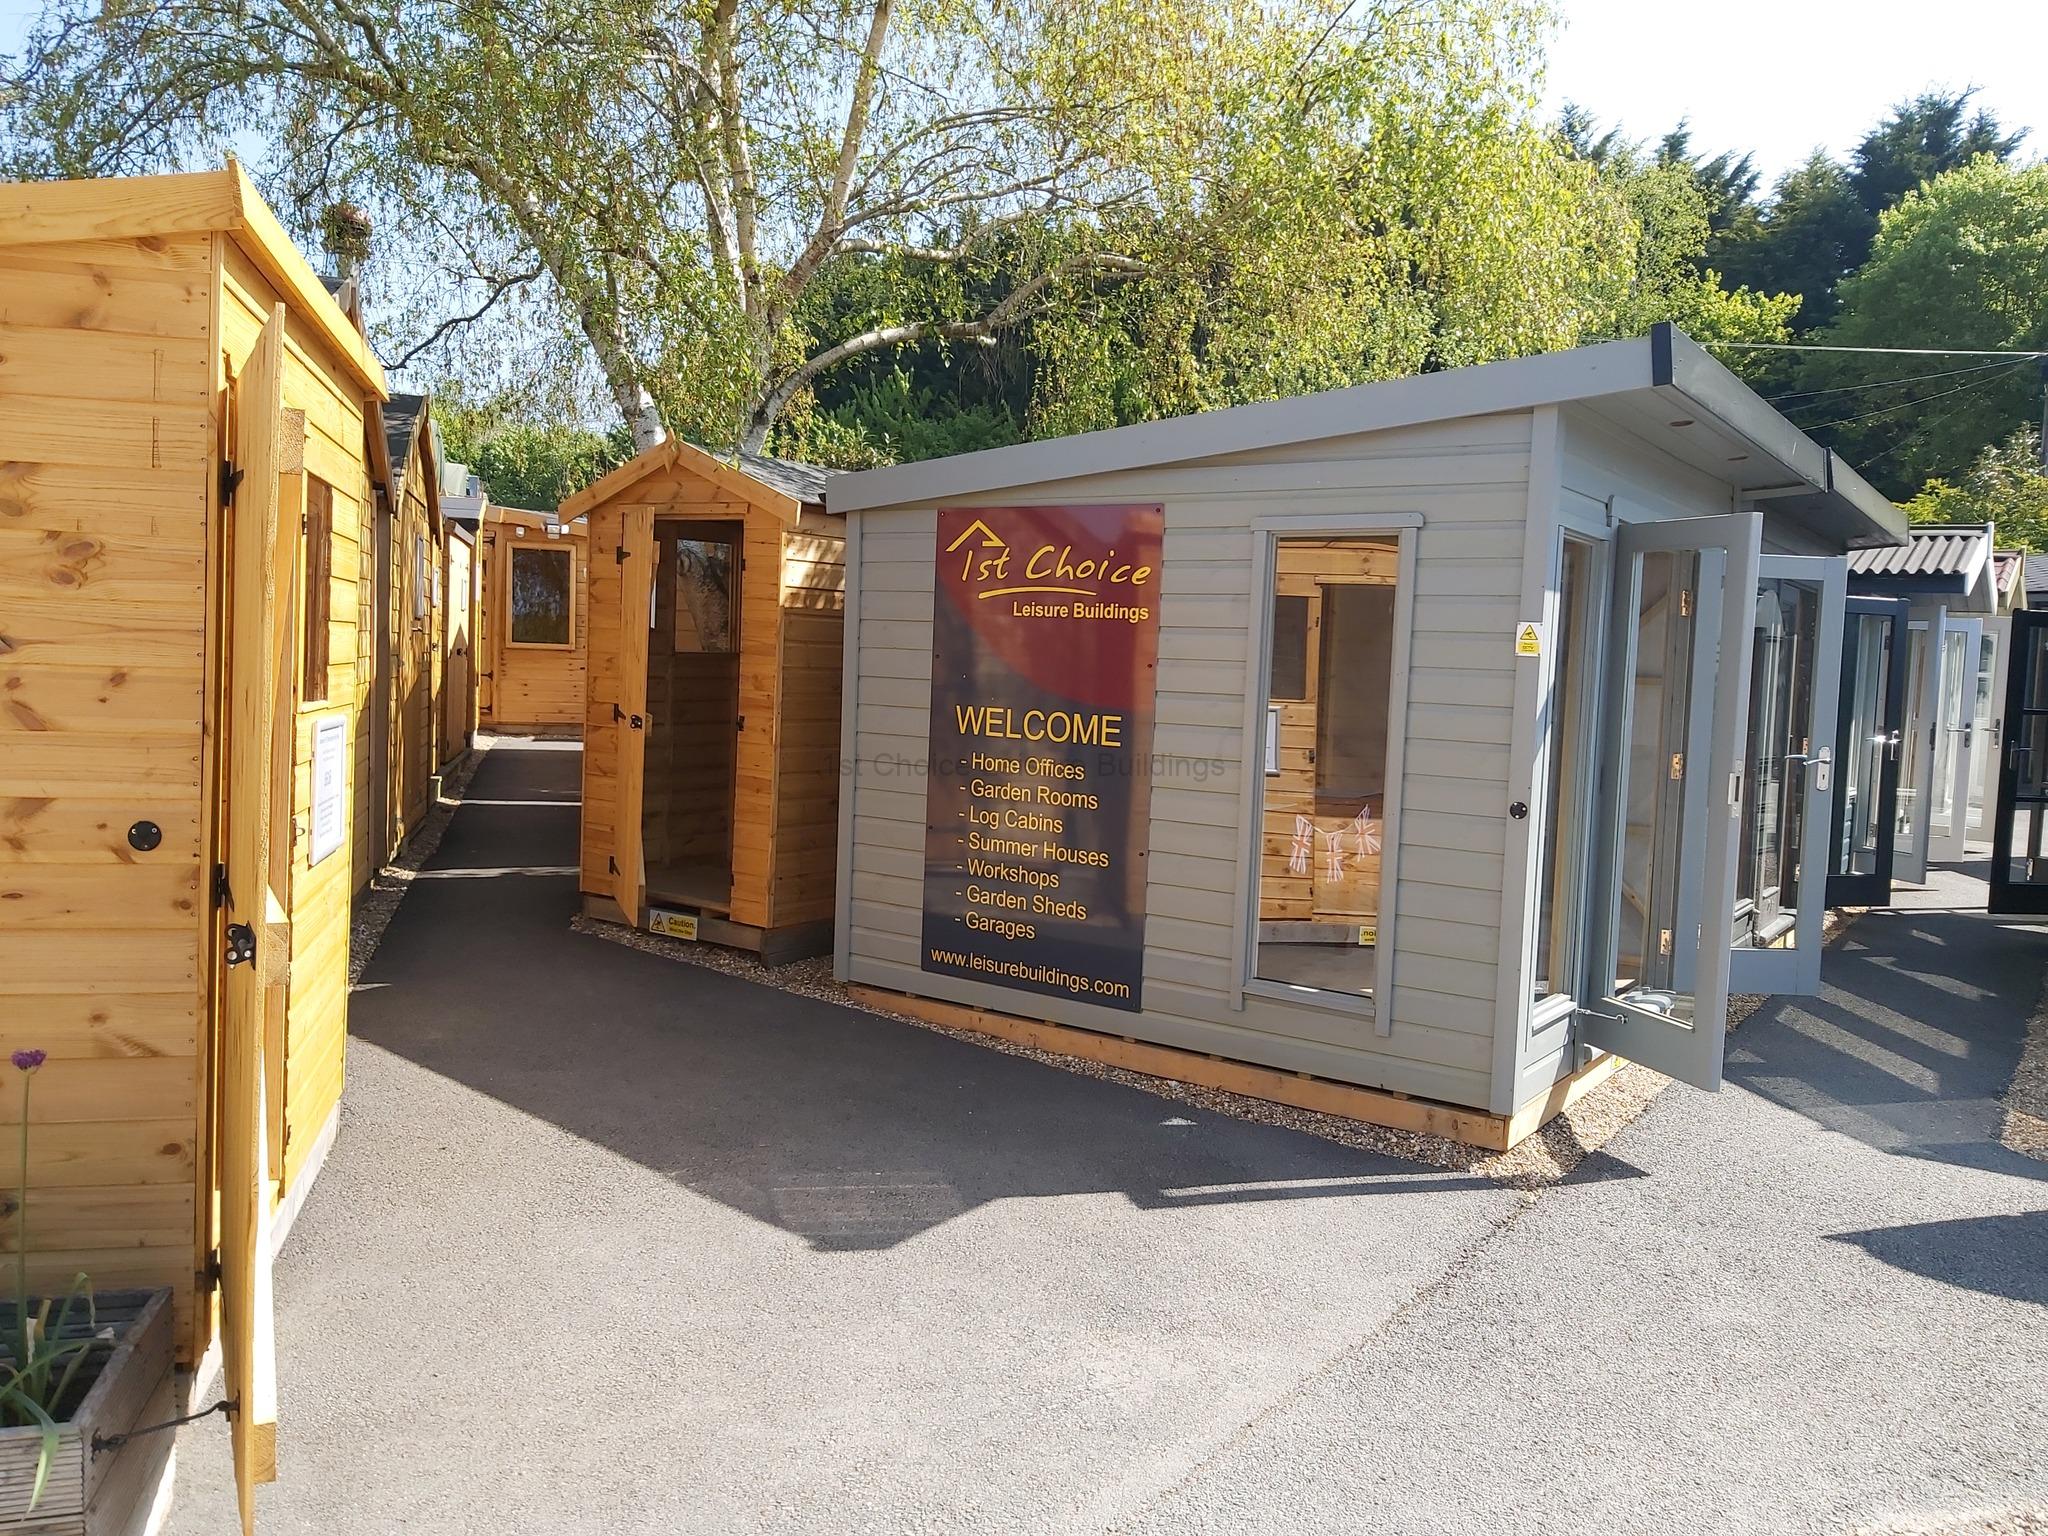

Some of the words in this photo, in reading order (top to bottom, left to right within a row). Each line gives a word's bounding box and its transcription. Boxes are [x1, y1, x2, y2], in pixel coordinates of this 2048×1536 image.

[961, 547, 1010, 582] 1st
[1025, 545, 1152, 585] Choice
[1013, 601, 1069, 618] Leisure
[1073, 602, 1149, 624] Buildings
[956, 705, 1122, 747] WELCOME
[972, 752, 1020, 774] Home
[1025, 757, 1085, 780] Offices
[971, 778, 1031, 803] Garden
[1037, 785, 1098, 810] Rooms
[969, 805, 1000, 830] Log
[1004, 809, 1063, 834] Cabins
[968, 831, 1038, 858] Summer
[1043, 840, 1109, 867] Houses
[967, 857, 1059, 891] Workshops
[966, 884, 1027, 911] Garden
[1032, 894, 1087, 920] Sheds
[965, 911, 1035, 940] Garages
[931, 948, 1130, 999] www.leisurebuildings.com
